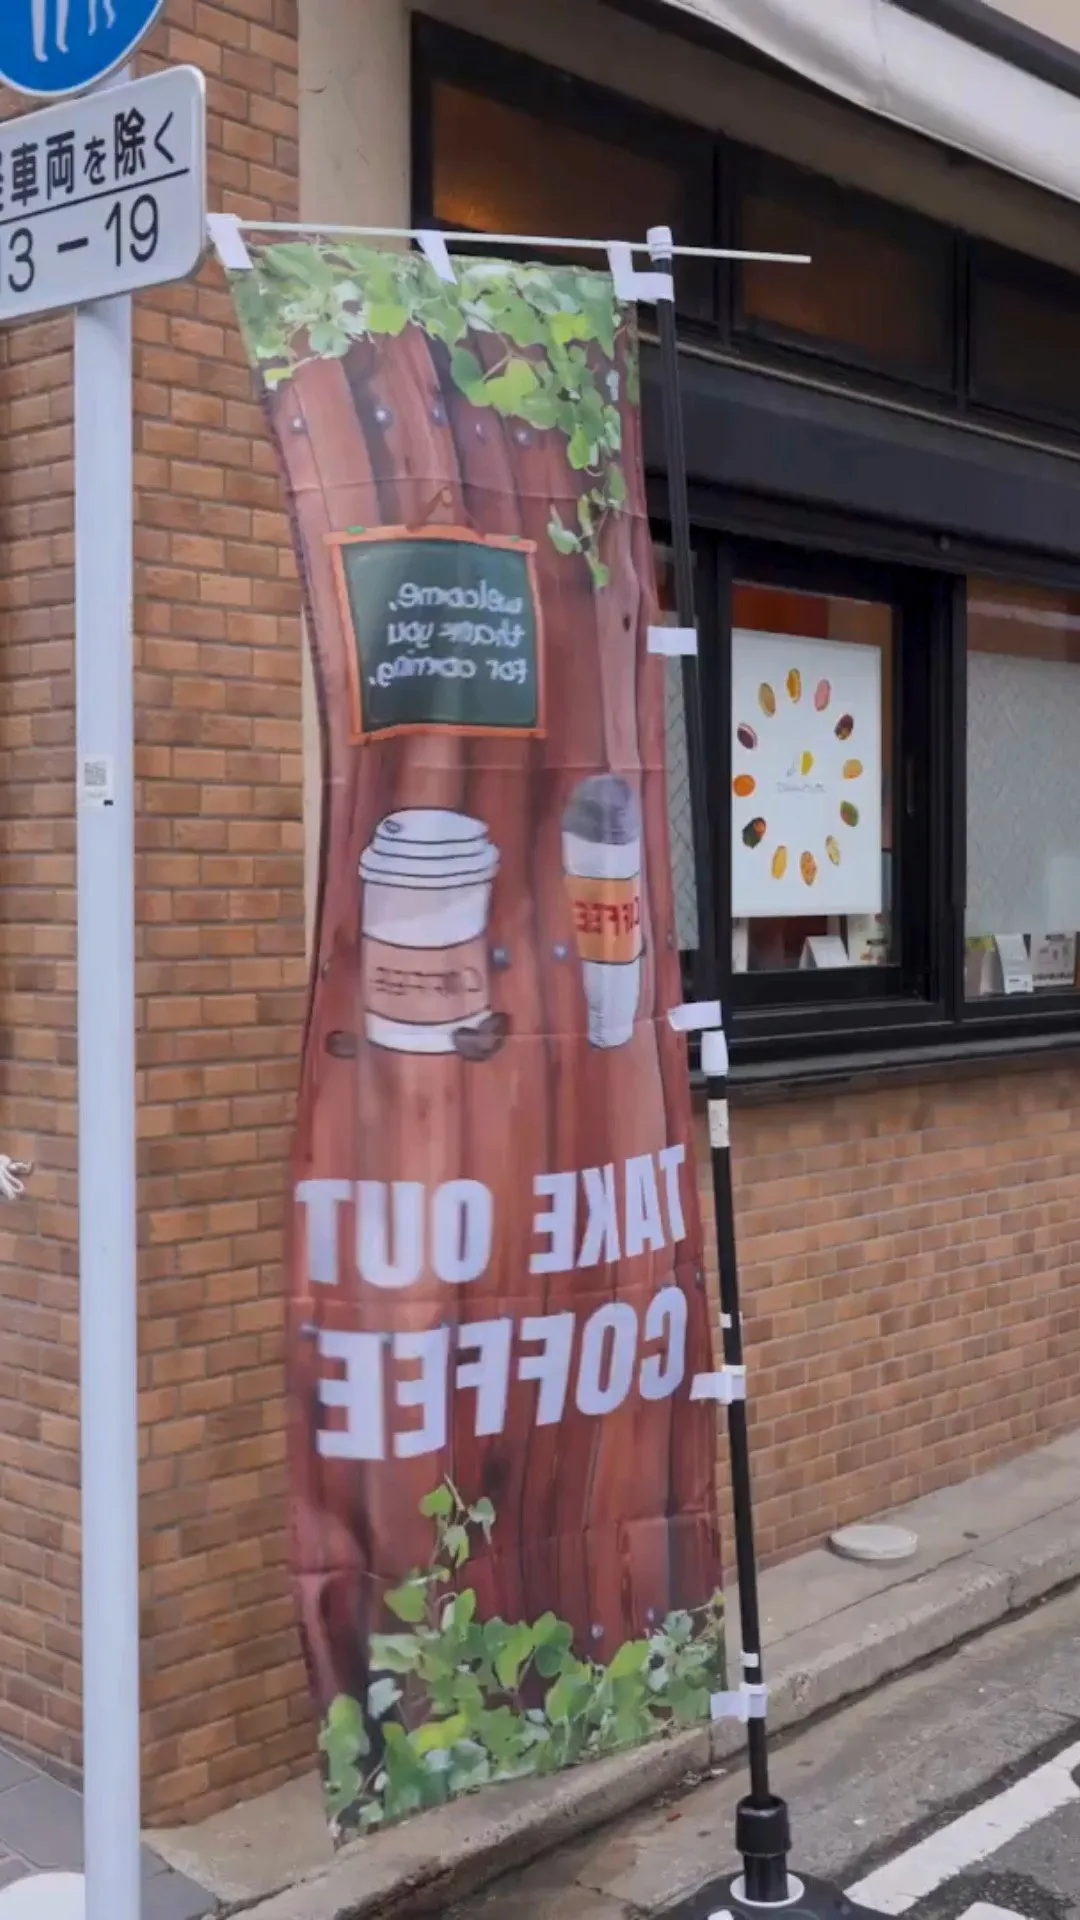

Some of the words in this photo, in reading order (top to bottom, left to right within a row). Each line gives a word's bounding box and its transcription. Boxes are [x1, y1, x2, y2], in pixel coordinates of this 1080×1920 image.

[0, 107, 174, 212] 車両を除く
